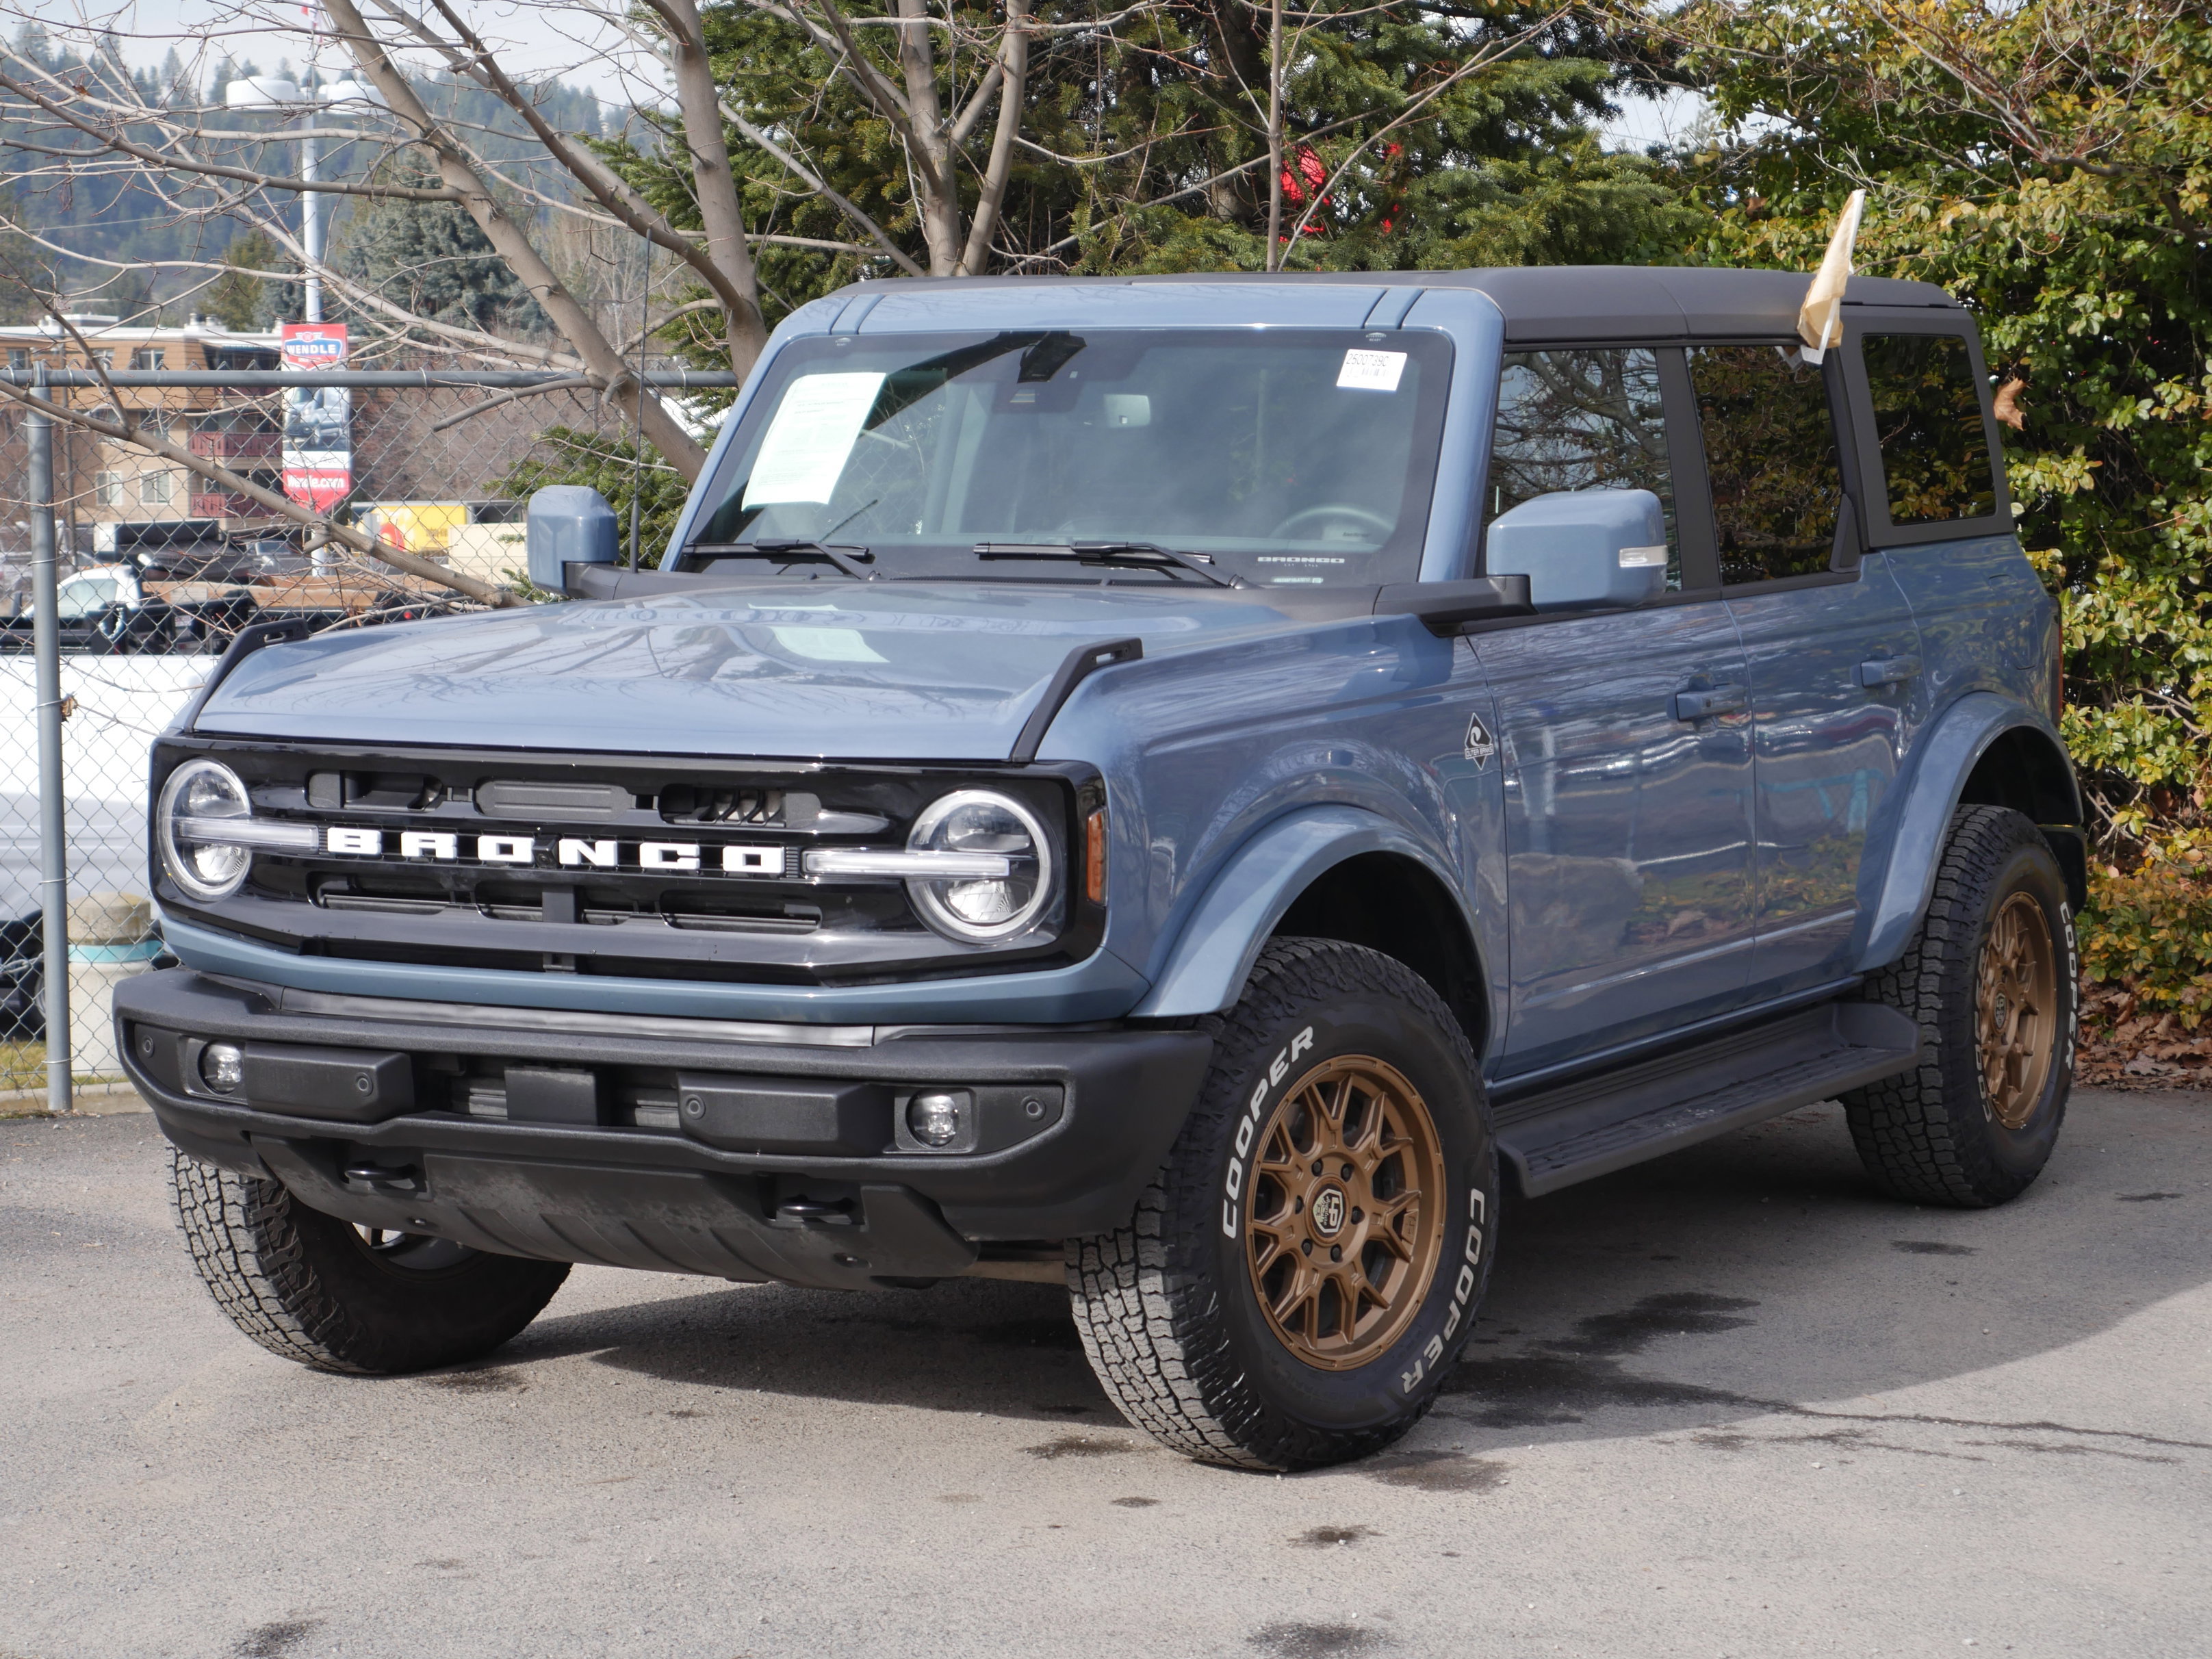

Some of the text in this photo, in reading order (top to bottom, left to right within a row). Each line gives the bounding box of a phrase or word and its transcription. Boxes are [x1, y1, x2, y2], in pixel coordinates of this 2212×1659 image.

[286, 344, 336, 355] WENDLE
[327, 827, 784, 874] BRONCO
[2060, 901, 2078, 1070] COOPER
[1222, 1026, 1314, 1239] COOPER
[1400, 1188, 1486, 1395] COOPER
